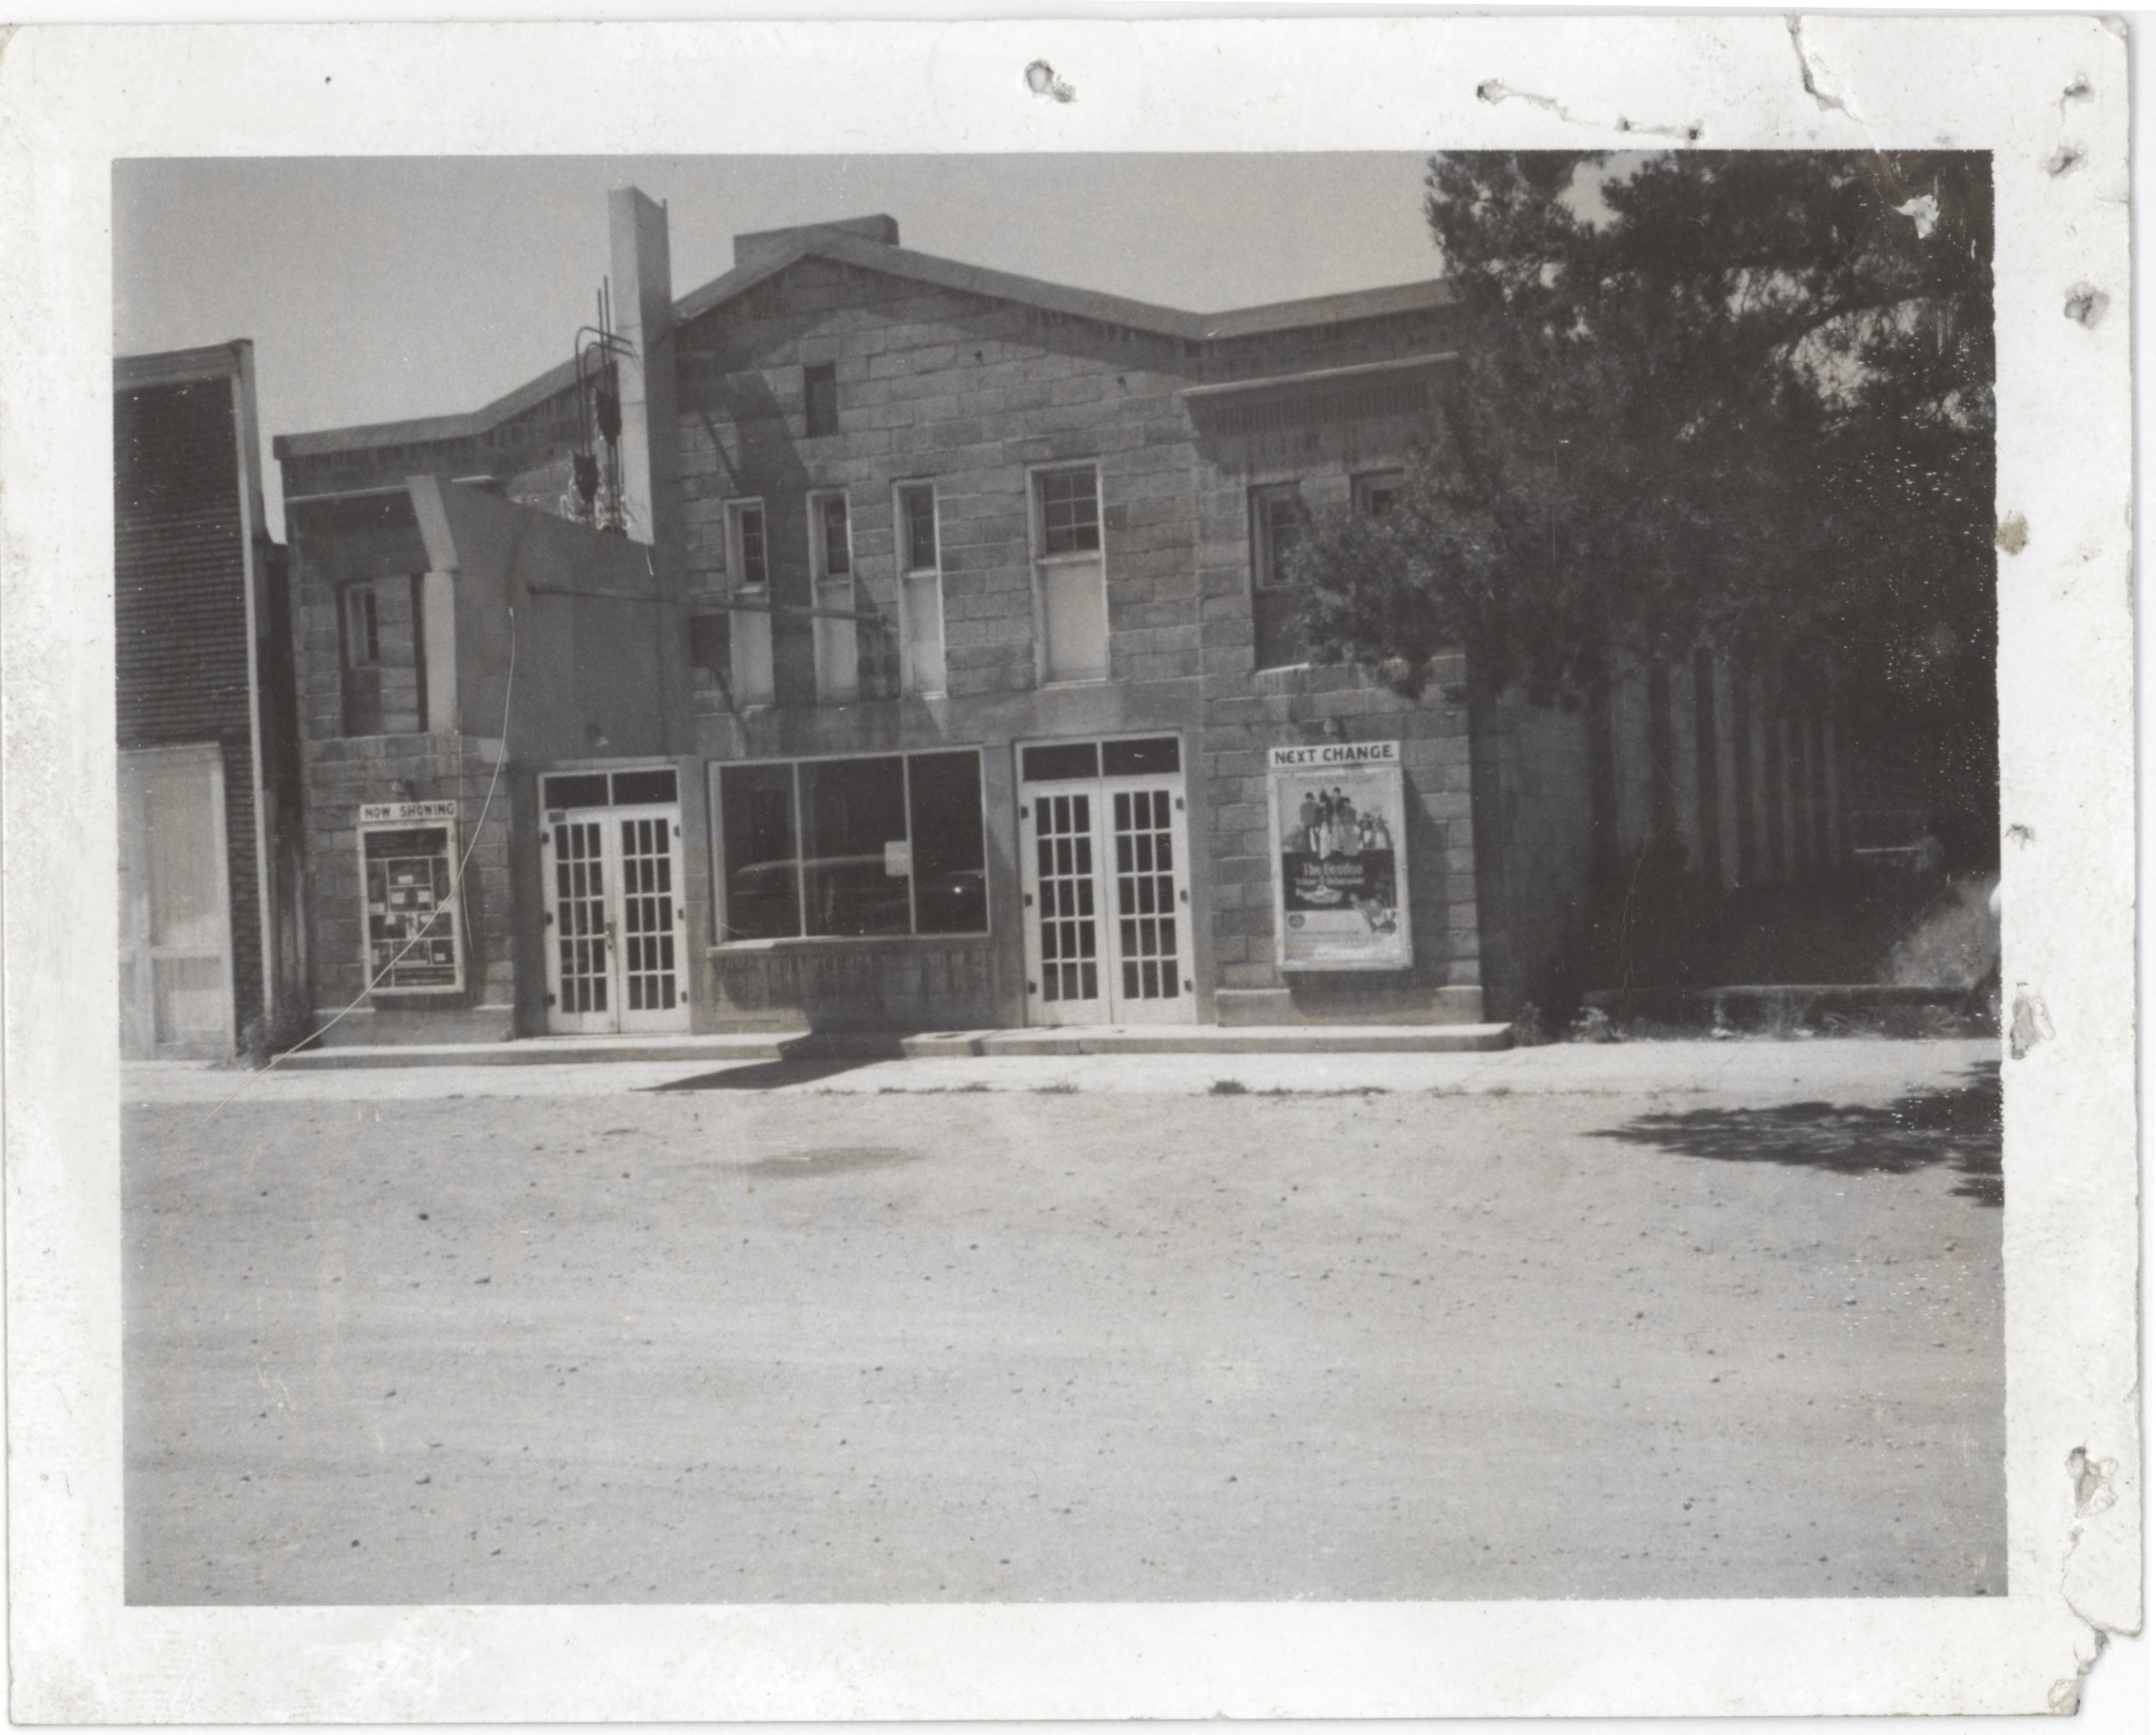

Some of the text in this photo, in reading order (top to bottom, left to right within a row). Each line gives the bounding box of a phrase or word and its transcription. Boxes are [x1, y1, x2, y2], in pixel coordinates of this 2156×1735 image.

[1275, 743, 1394, 765] NEXT CHANGE
[365, 802, 455, 819] NOW SHOWING
